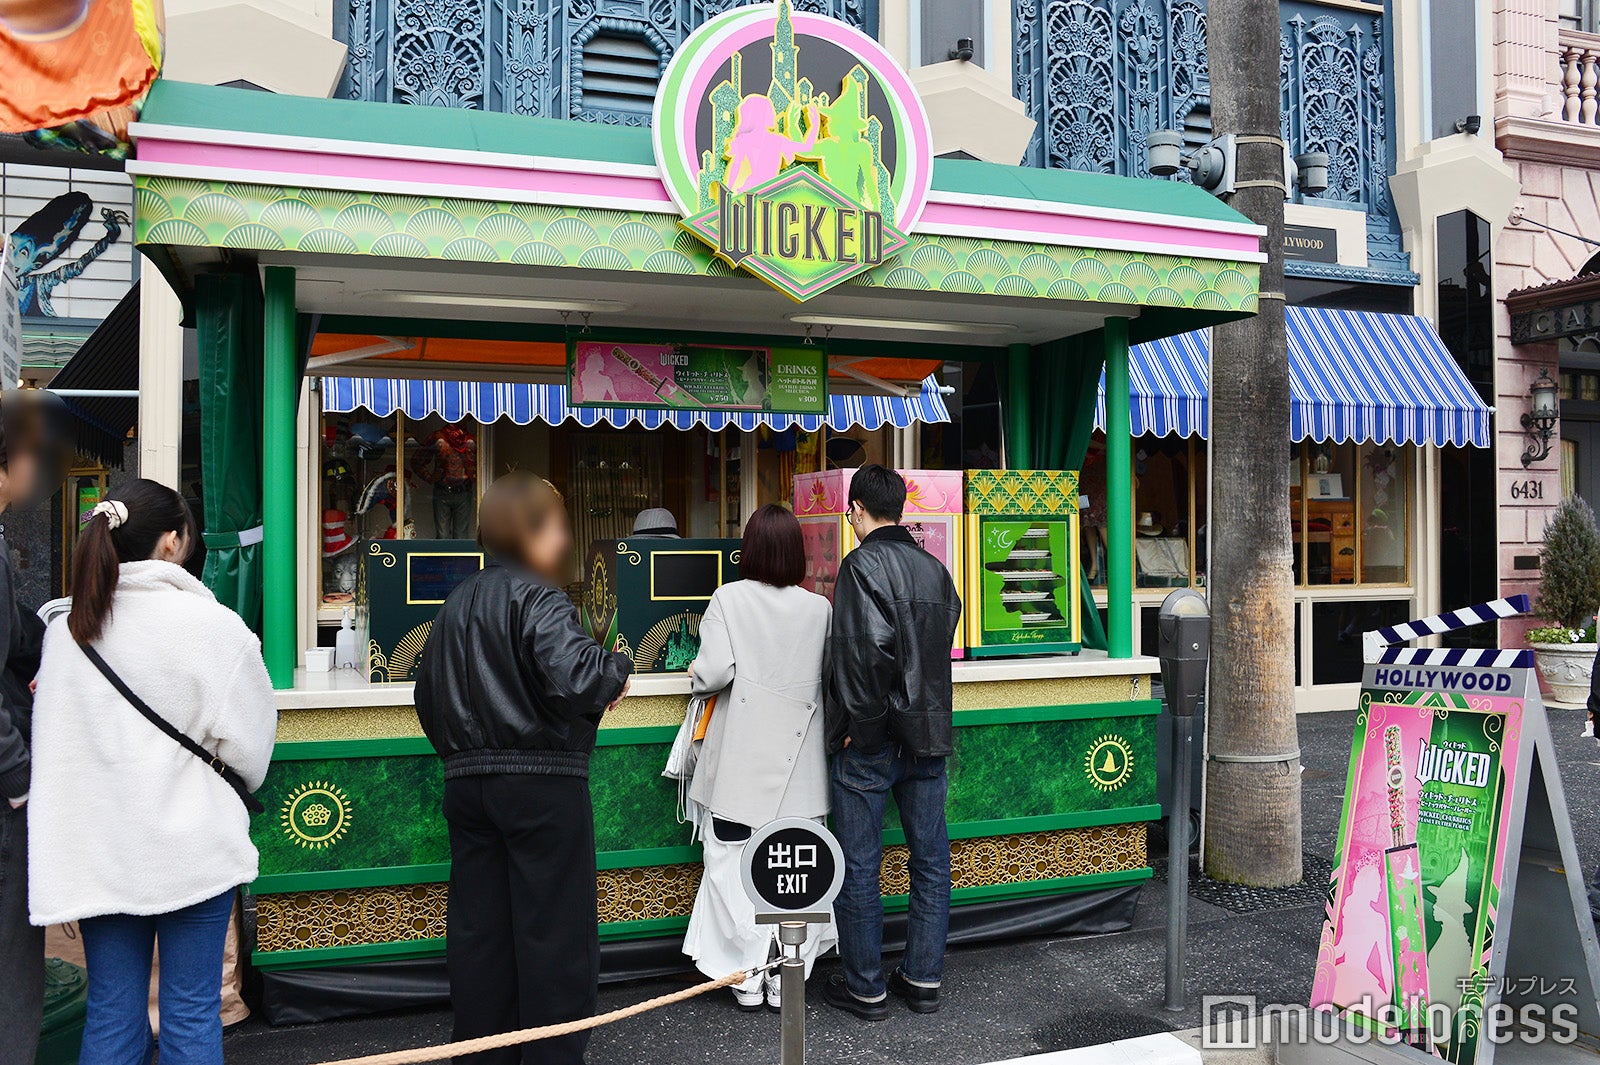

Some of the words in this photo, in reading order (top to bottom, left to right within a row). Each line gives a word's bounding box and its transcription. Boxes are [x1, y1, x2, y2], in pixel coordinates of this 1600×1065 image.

[714, 182, 884, 267] WICKED
[1283, 236, 1324, 250] LYWOOD
[660, 353, 689, 366] WICKED
[778, 365, 817, 375] DRINKS
[1511, 480, 1543, 499] 6431
[1375, 669, 1512, 691] HOLLYWOOD
[1415, 738, 1491, 787] WICKED
[768, 843, 817, 869] 出口
[777, 874, 808, 894] EXIT
